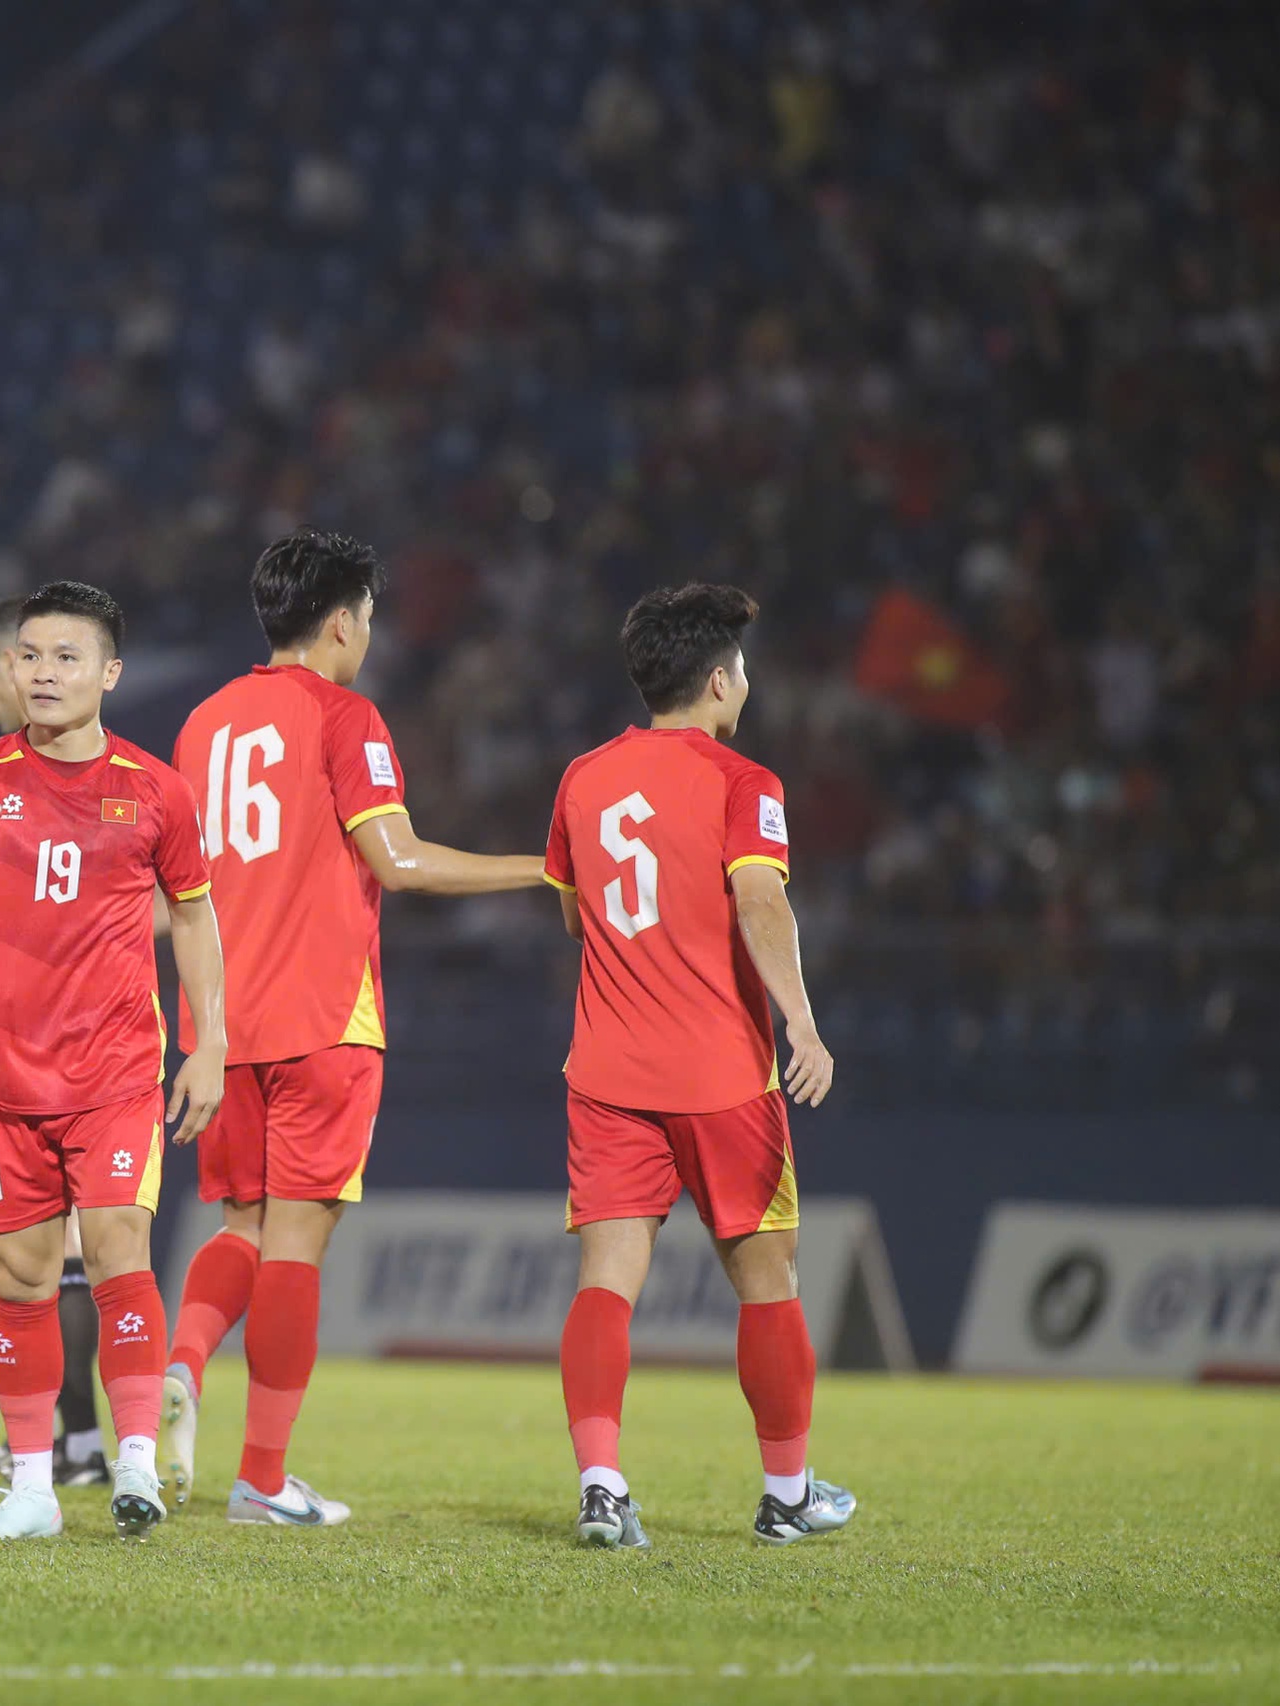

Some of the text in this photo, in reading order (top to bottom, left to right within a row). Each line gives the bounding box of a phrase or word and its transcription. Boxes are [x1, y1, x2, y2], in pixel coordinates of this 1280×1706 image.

[205, 723, 285, 864] 16
[34, 839, 82, 904] 19
[600, 791, 660, 940] 5
